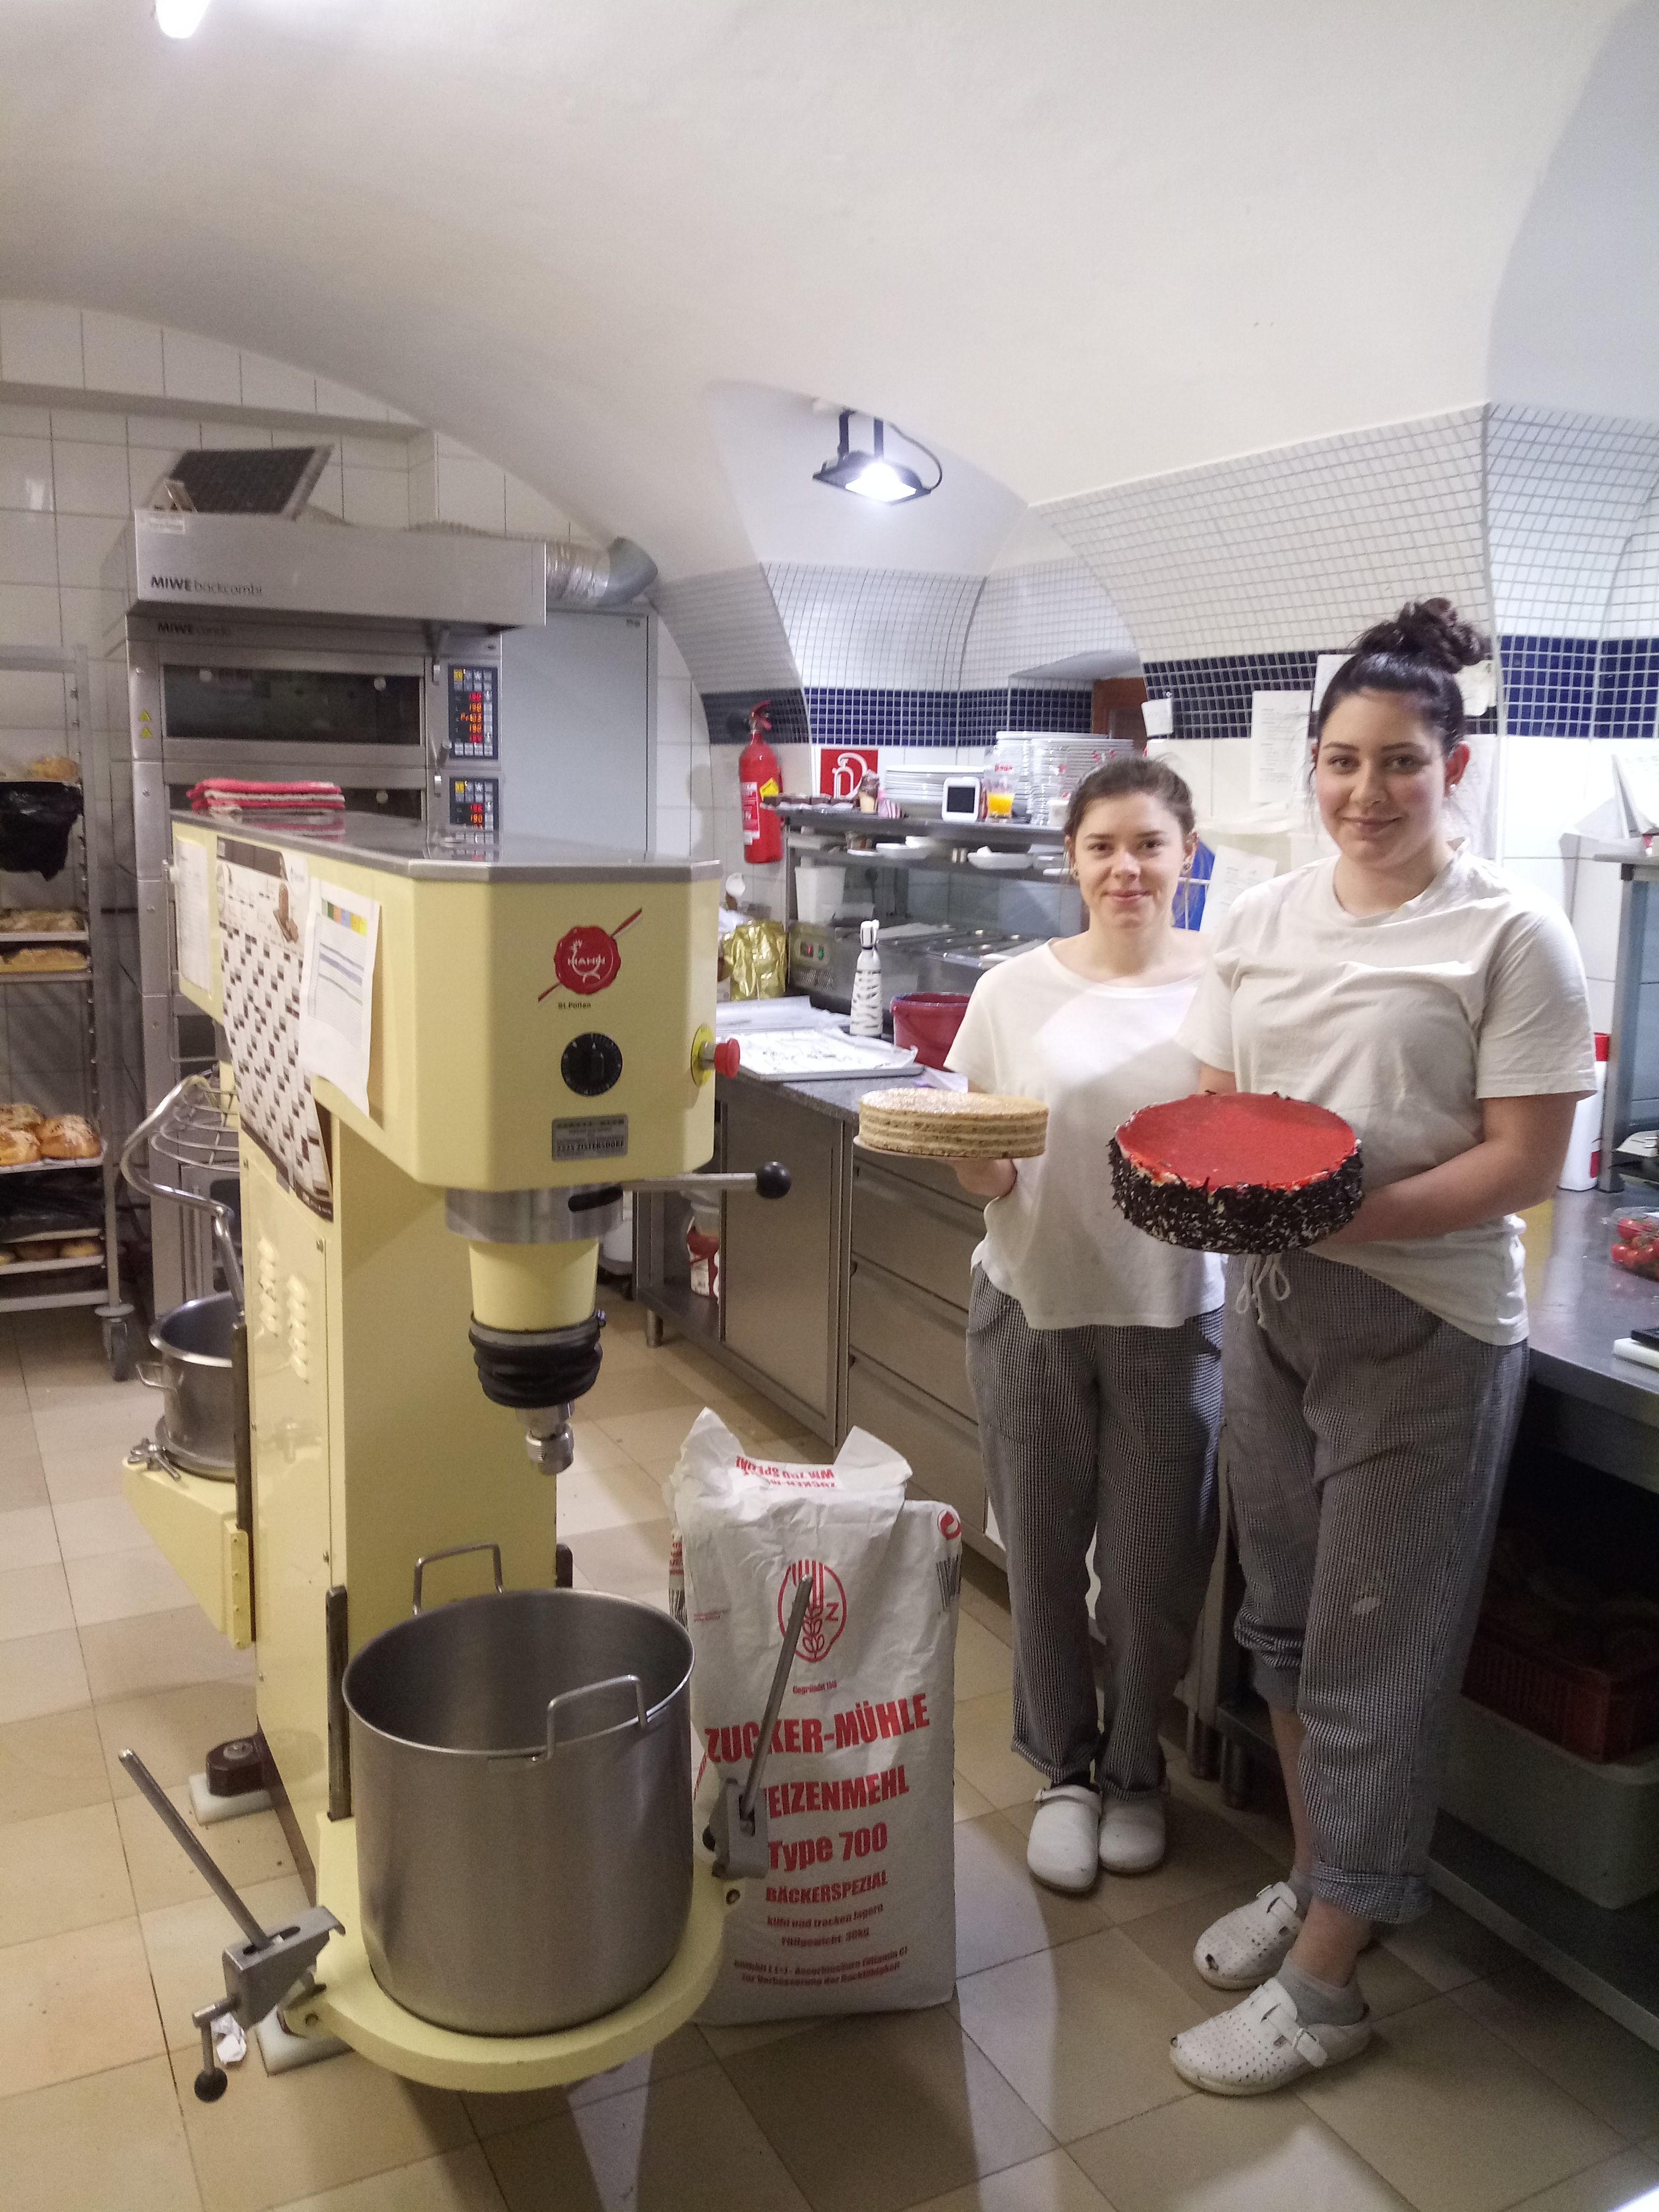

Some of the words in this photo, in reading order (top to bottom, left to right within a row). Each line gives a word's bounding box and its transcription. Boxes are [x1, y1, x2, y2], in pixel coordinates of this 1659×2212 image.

[151, 575, 192, 592] MIWE
[158, 621, 194, 635] MIWE
[825, 1602, 839, 1622] Z
[704, 1692, 930, 1763] ZUCKER-MÜHLE
[764, 1765, 910, 1819] EIZENMEHL
[768, 1836, 833, 1872] Type
[839, 1822, 888, 1861] 700
[765, 1869, 889, 1904] BÄCKERSPEZIAL
